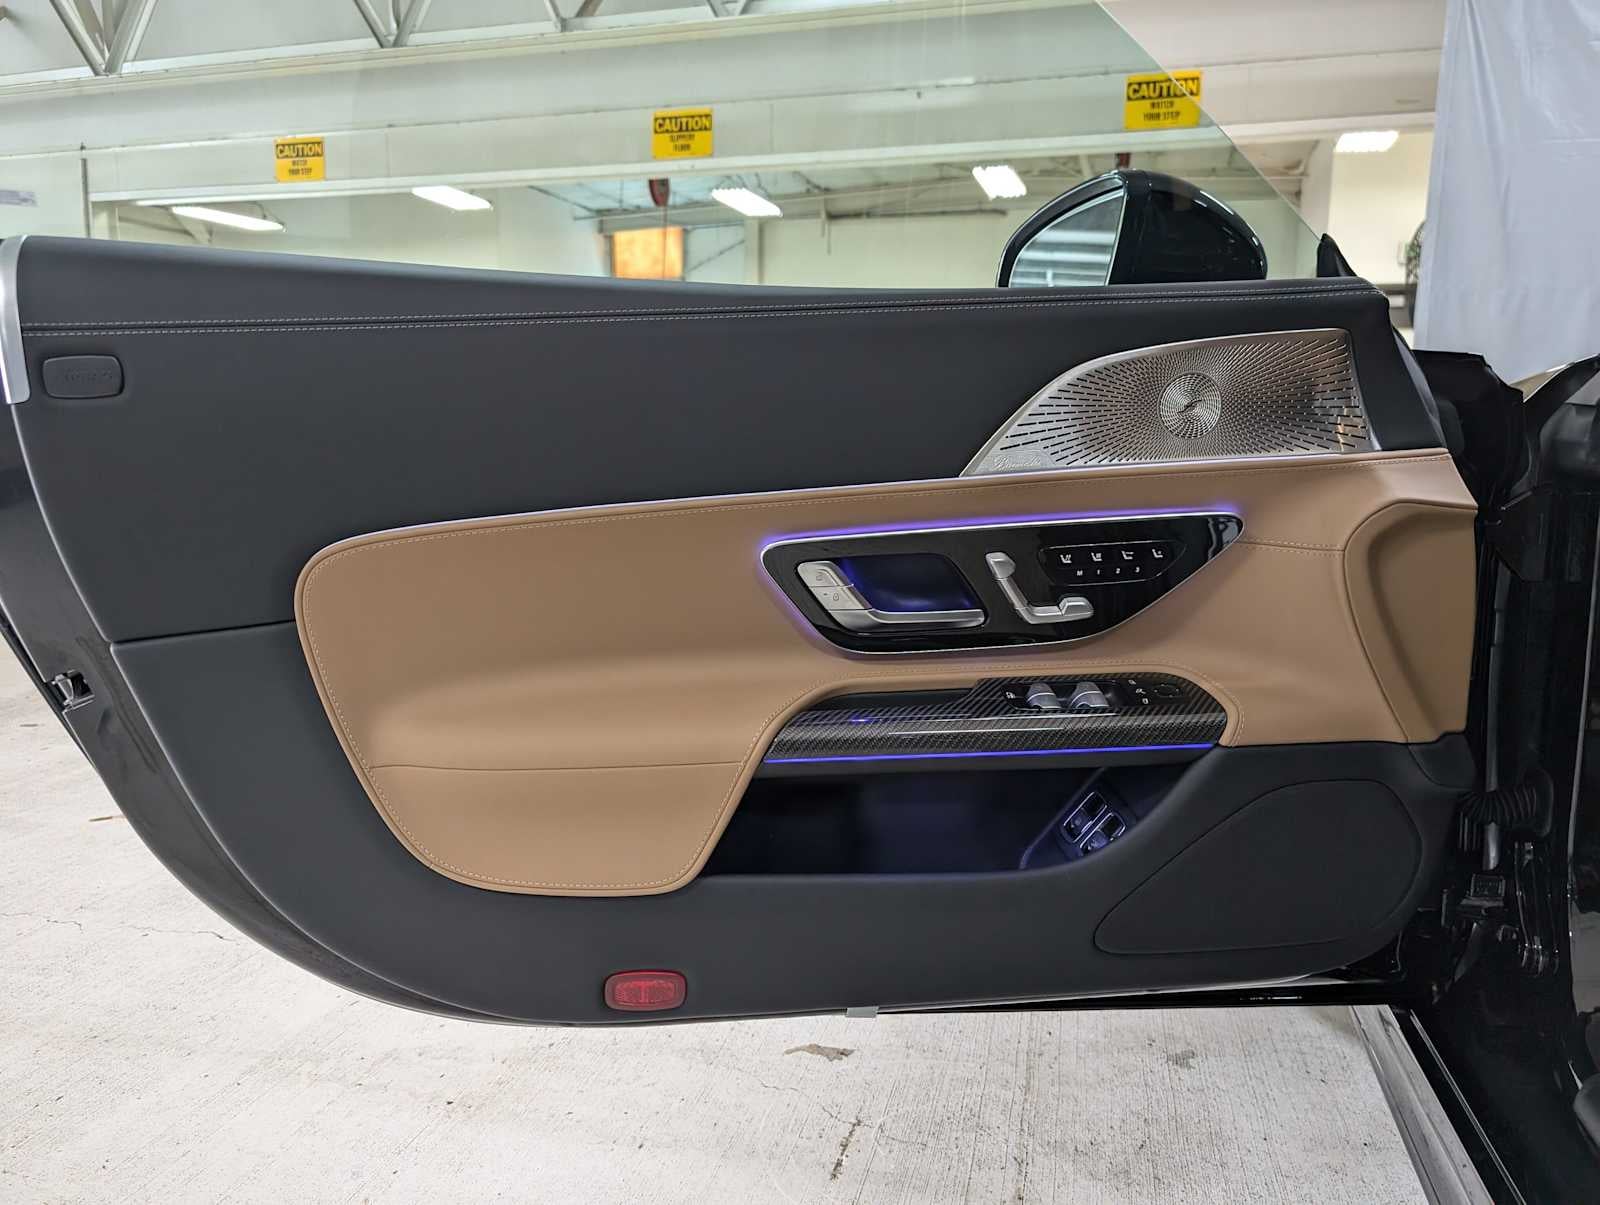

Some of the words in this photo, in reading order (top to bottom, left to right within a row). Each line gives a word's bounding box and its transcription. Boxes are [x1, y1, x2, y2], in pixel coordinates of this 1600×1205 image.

[1128, 79, 1198, 99] CAUTION
[656, 116, 710, 132] CAUTION
[277, 143, 322, 157] CAUTION
